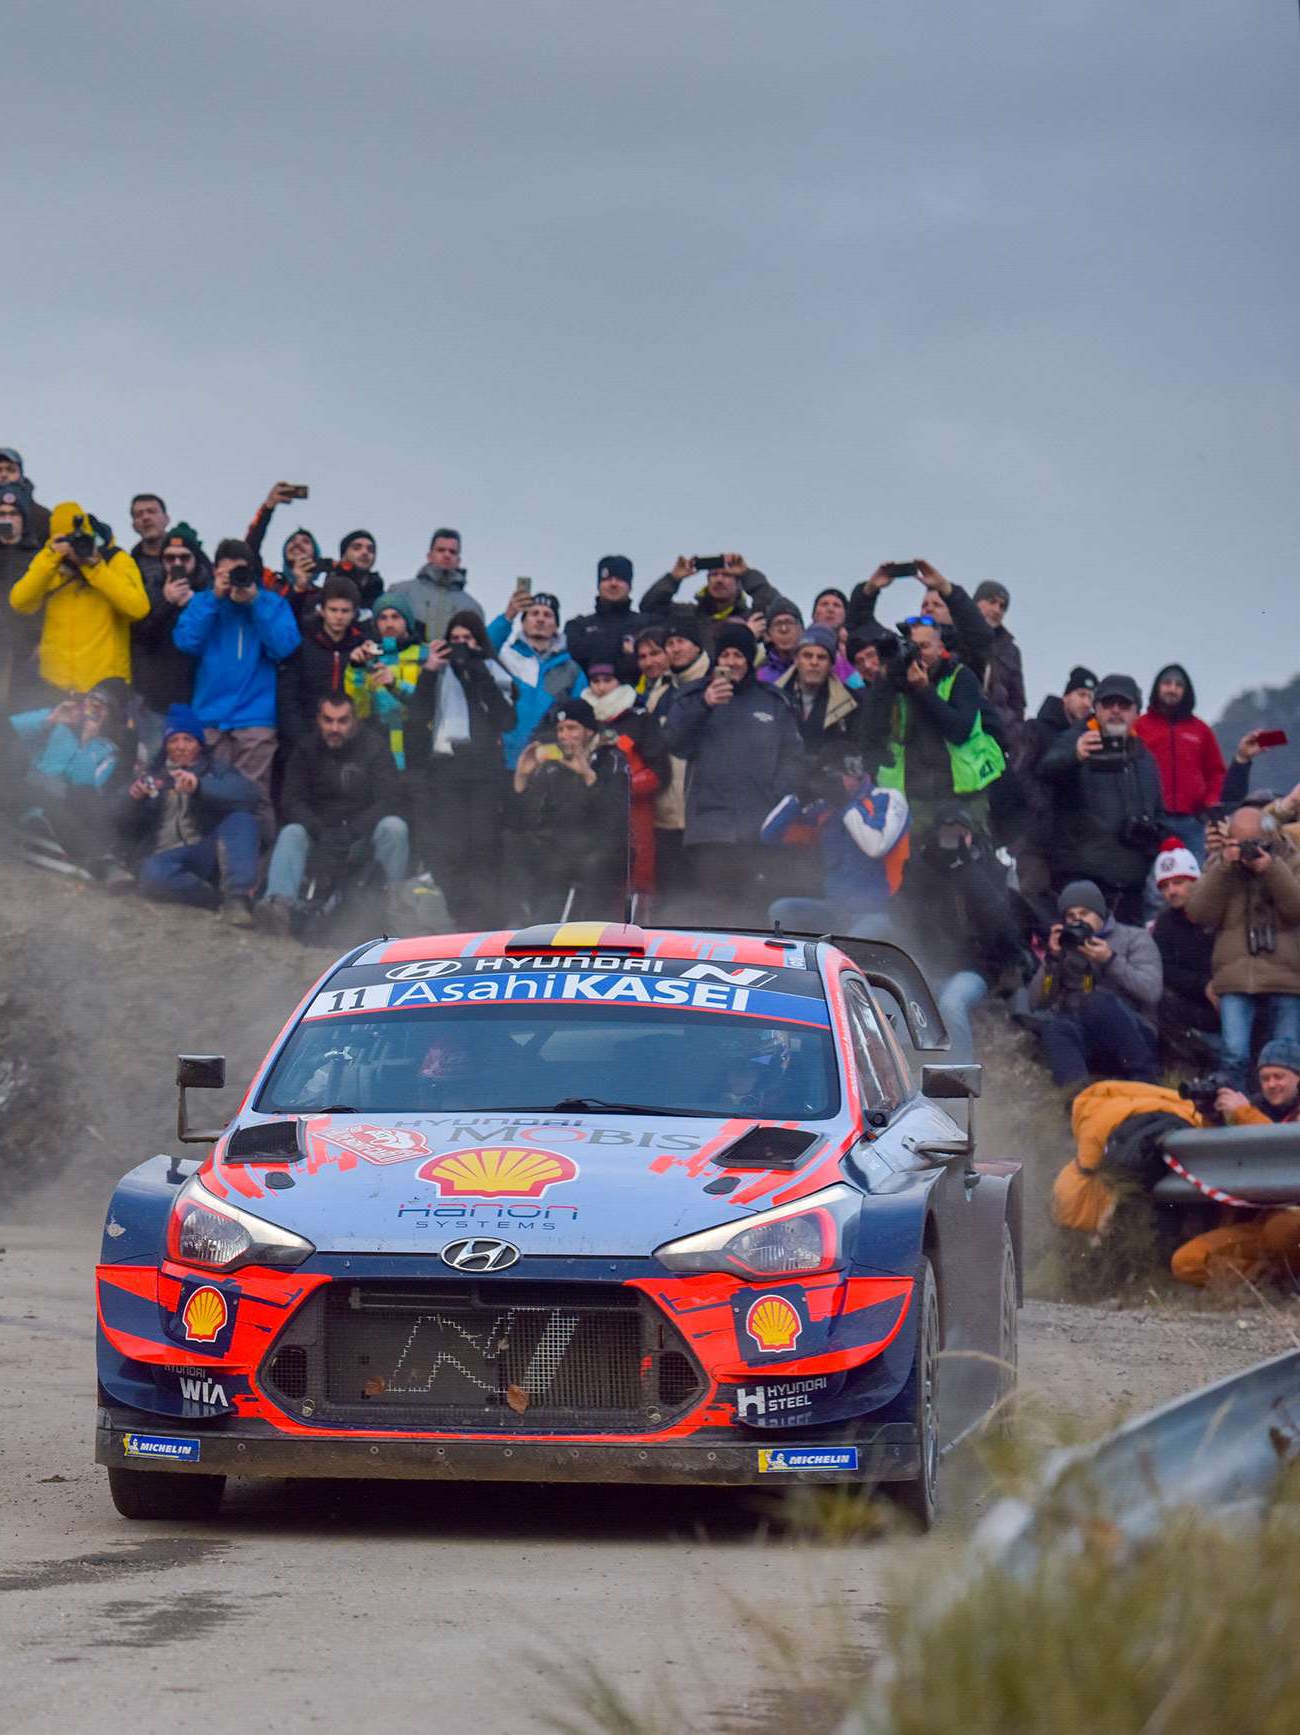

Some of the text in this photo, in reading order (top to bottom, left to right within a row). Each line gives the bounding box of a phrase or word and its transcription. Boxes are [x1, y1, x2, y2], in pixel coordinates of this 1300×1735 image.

[475, 957, 663, 972] HYUNDAI
[327, 988, 367, 1013] 11
[396, 1117, 585, 1128] HYUNDAI
[447, 1126, 702, 1151] MOBIS
[415, 1220, 556, 1231] SYSTEMS
[164, 1363, 206, 1379] HYUNDAI
[767, 1377, 827, 1398] HYUNDAI
[768, 1394, 813, 1412] STEEL
[139, 1442, 192, 1455] MICHELIN
[788, 1454, 851, 1465] MICHELIN
